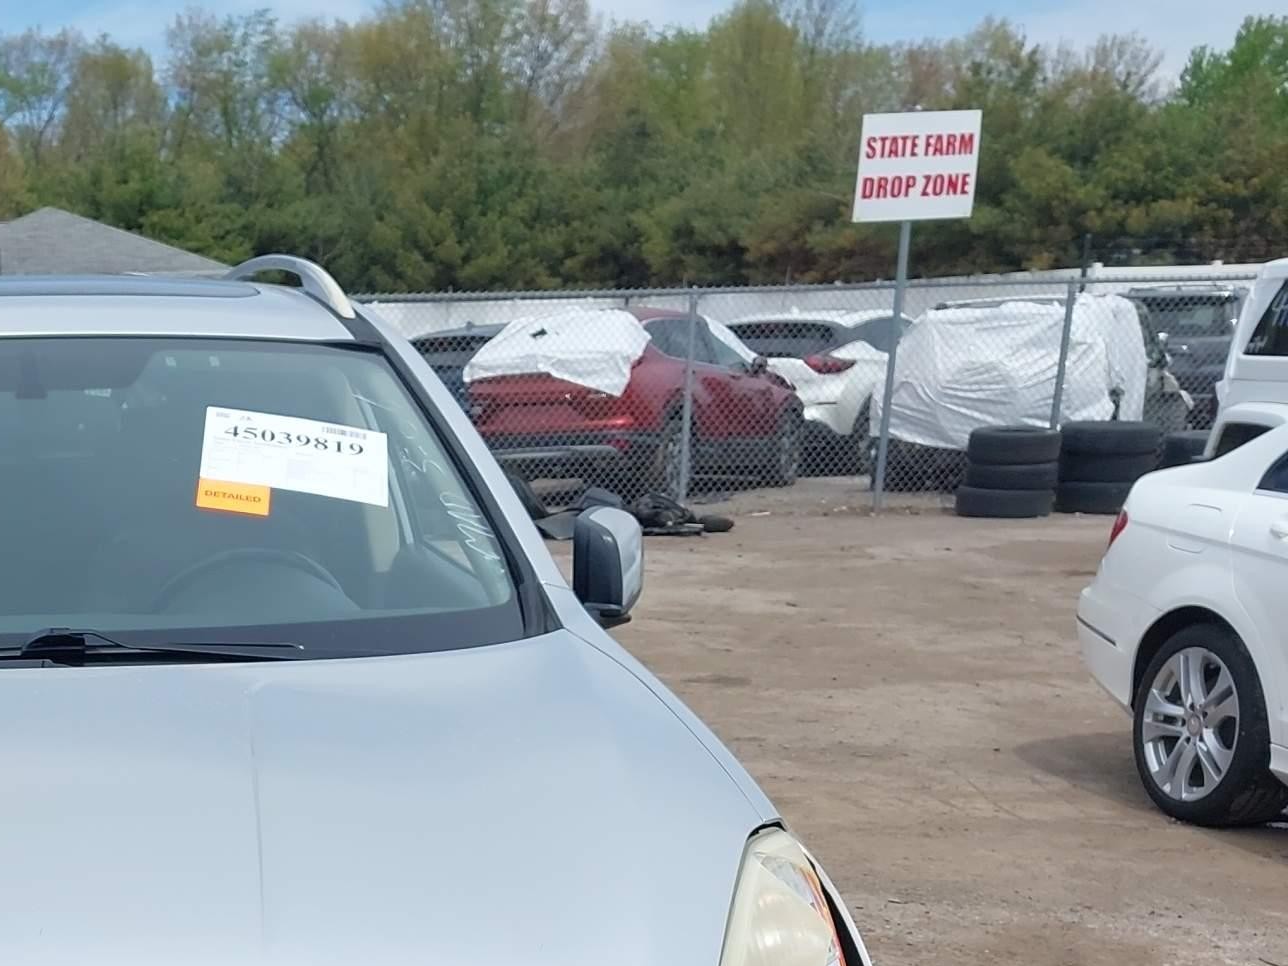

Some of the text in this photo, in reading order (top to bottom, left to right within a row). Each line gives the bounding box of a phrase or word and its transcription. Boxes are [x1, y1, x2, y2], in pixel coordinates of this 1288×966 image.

[865, 132, 974, 159] STATE FARM
[861, 173, 970, 199] DROP ZONE
[223, 424, 364, 456] 45039819
[204, 489, 262, 504] DETAILED
